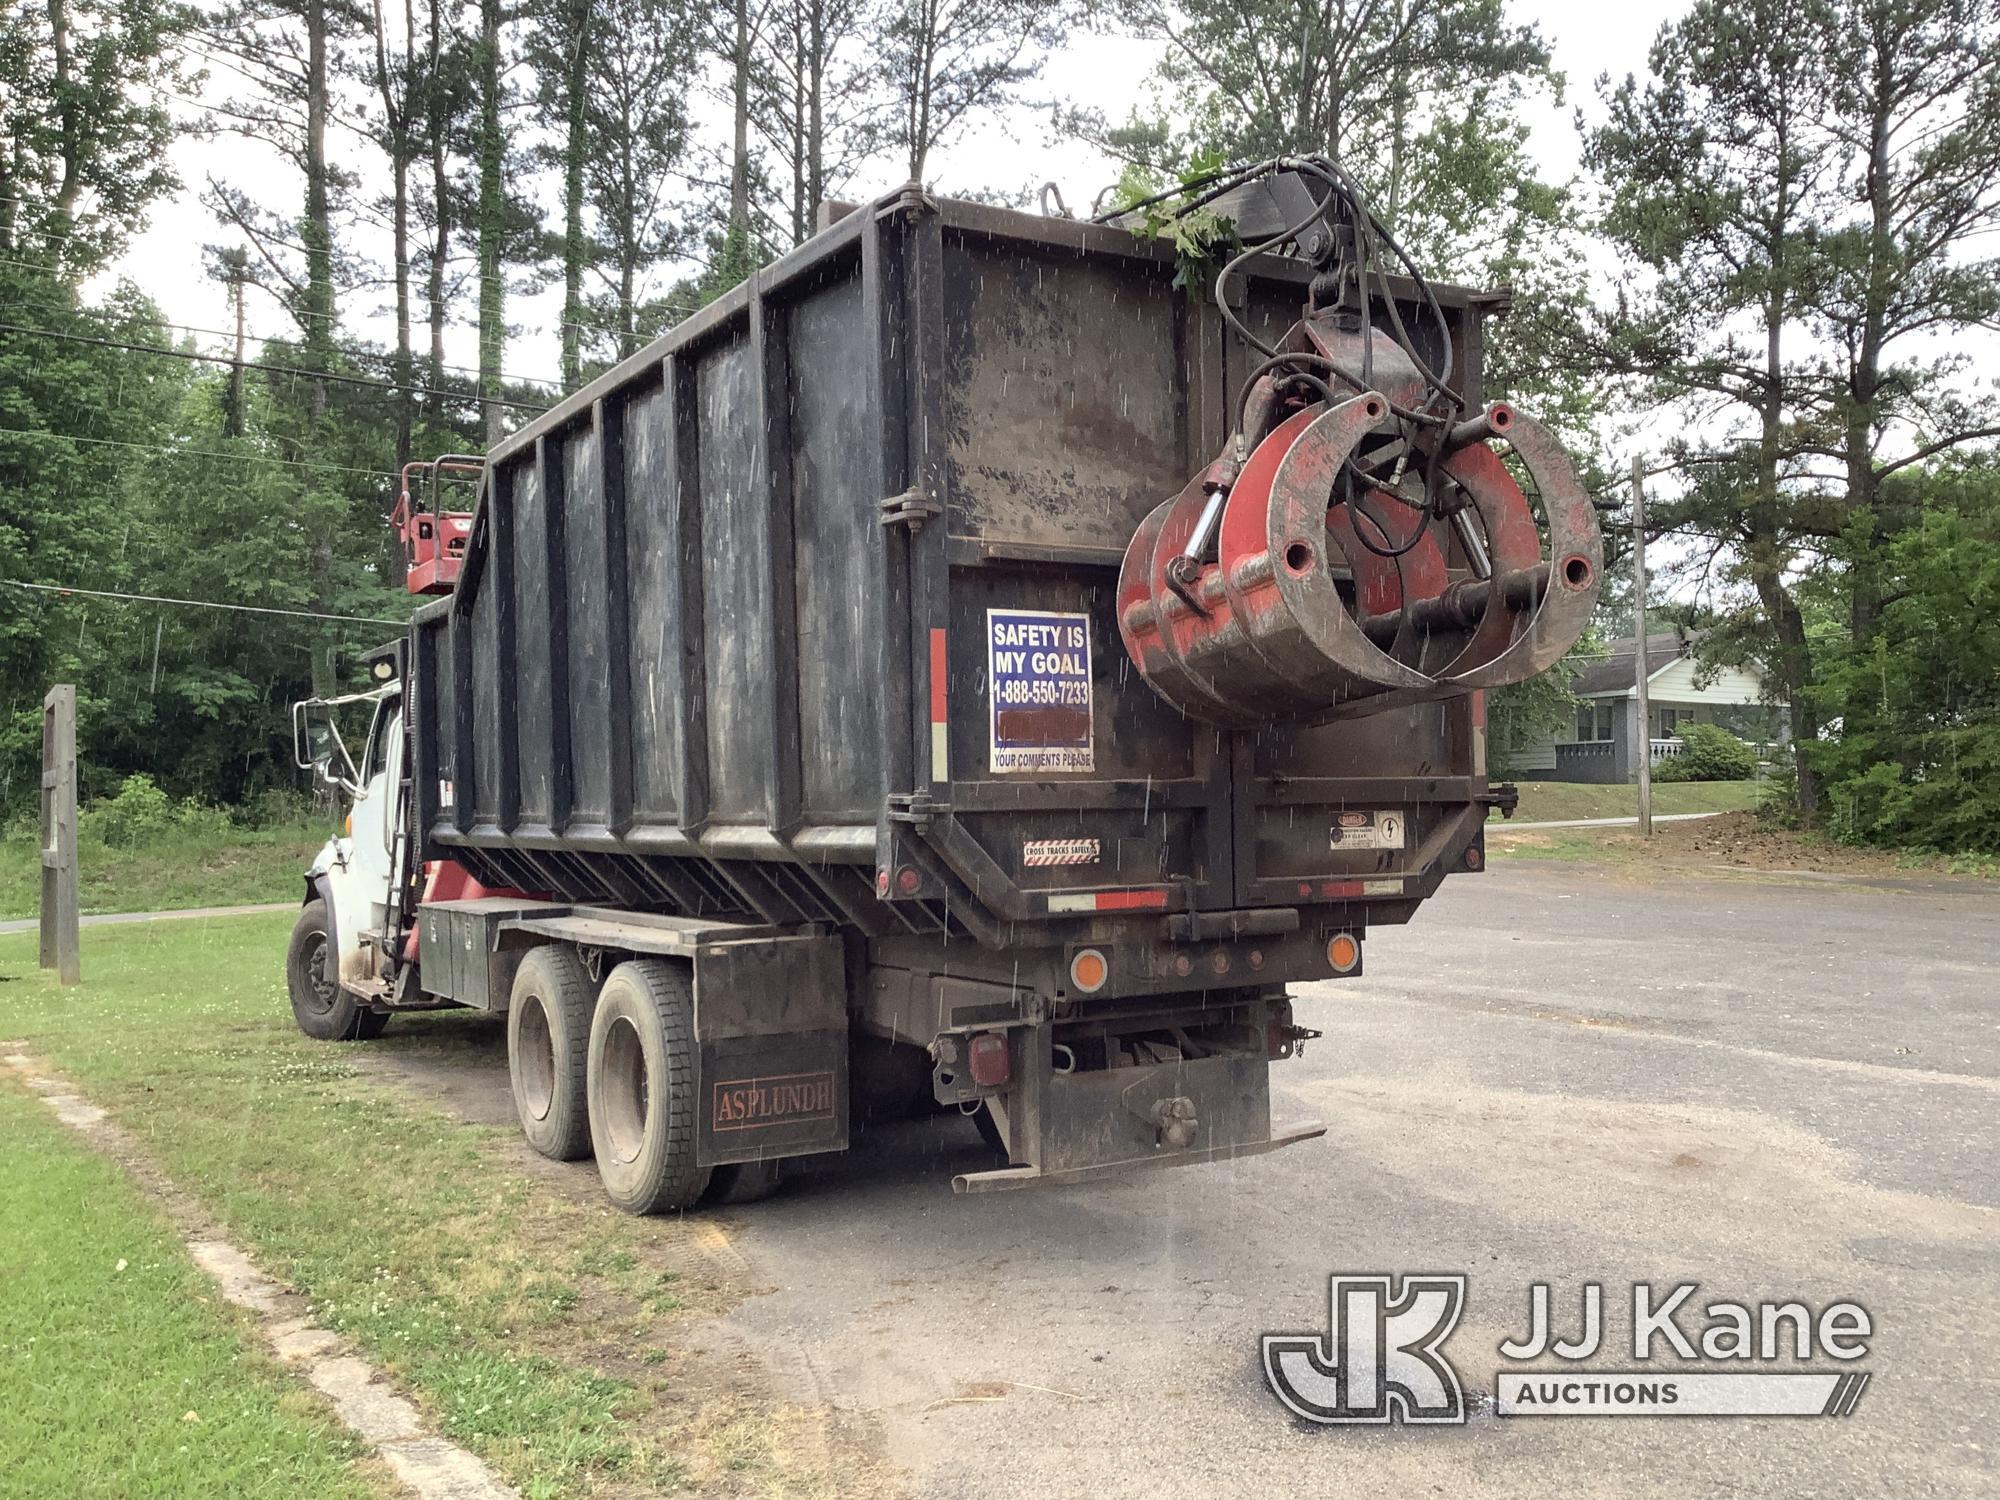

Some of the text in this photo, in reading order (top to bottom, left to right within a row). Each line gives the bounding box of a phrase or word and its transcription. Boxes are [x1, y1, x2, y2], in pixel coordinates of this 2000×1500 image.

[994, 623, 1084, 648] SAFETY IS
[995, 652, 1086, 675] MY GOAL
[994, 679, 1088, 705] 1-888-550-7233
[994, 752, 1091, 768] YOUR COMMENTS PLEASE
[1026, 847, 1045, 855] CROSS
[1046, 846, 1069, 855] TRACKS
[717, 1081, 831, 1121] ASPLUNDH
